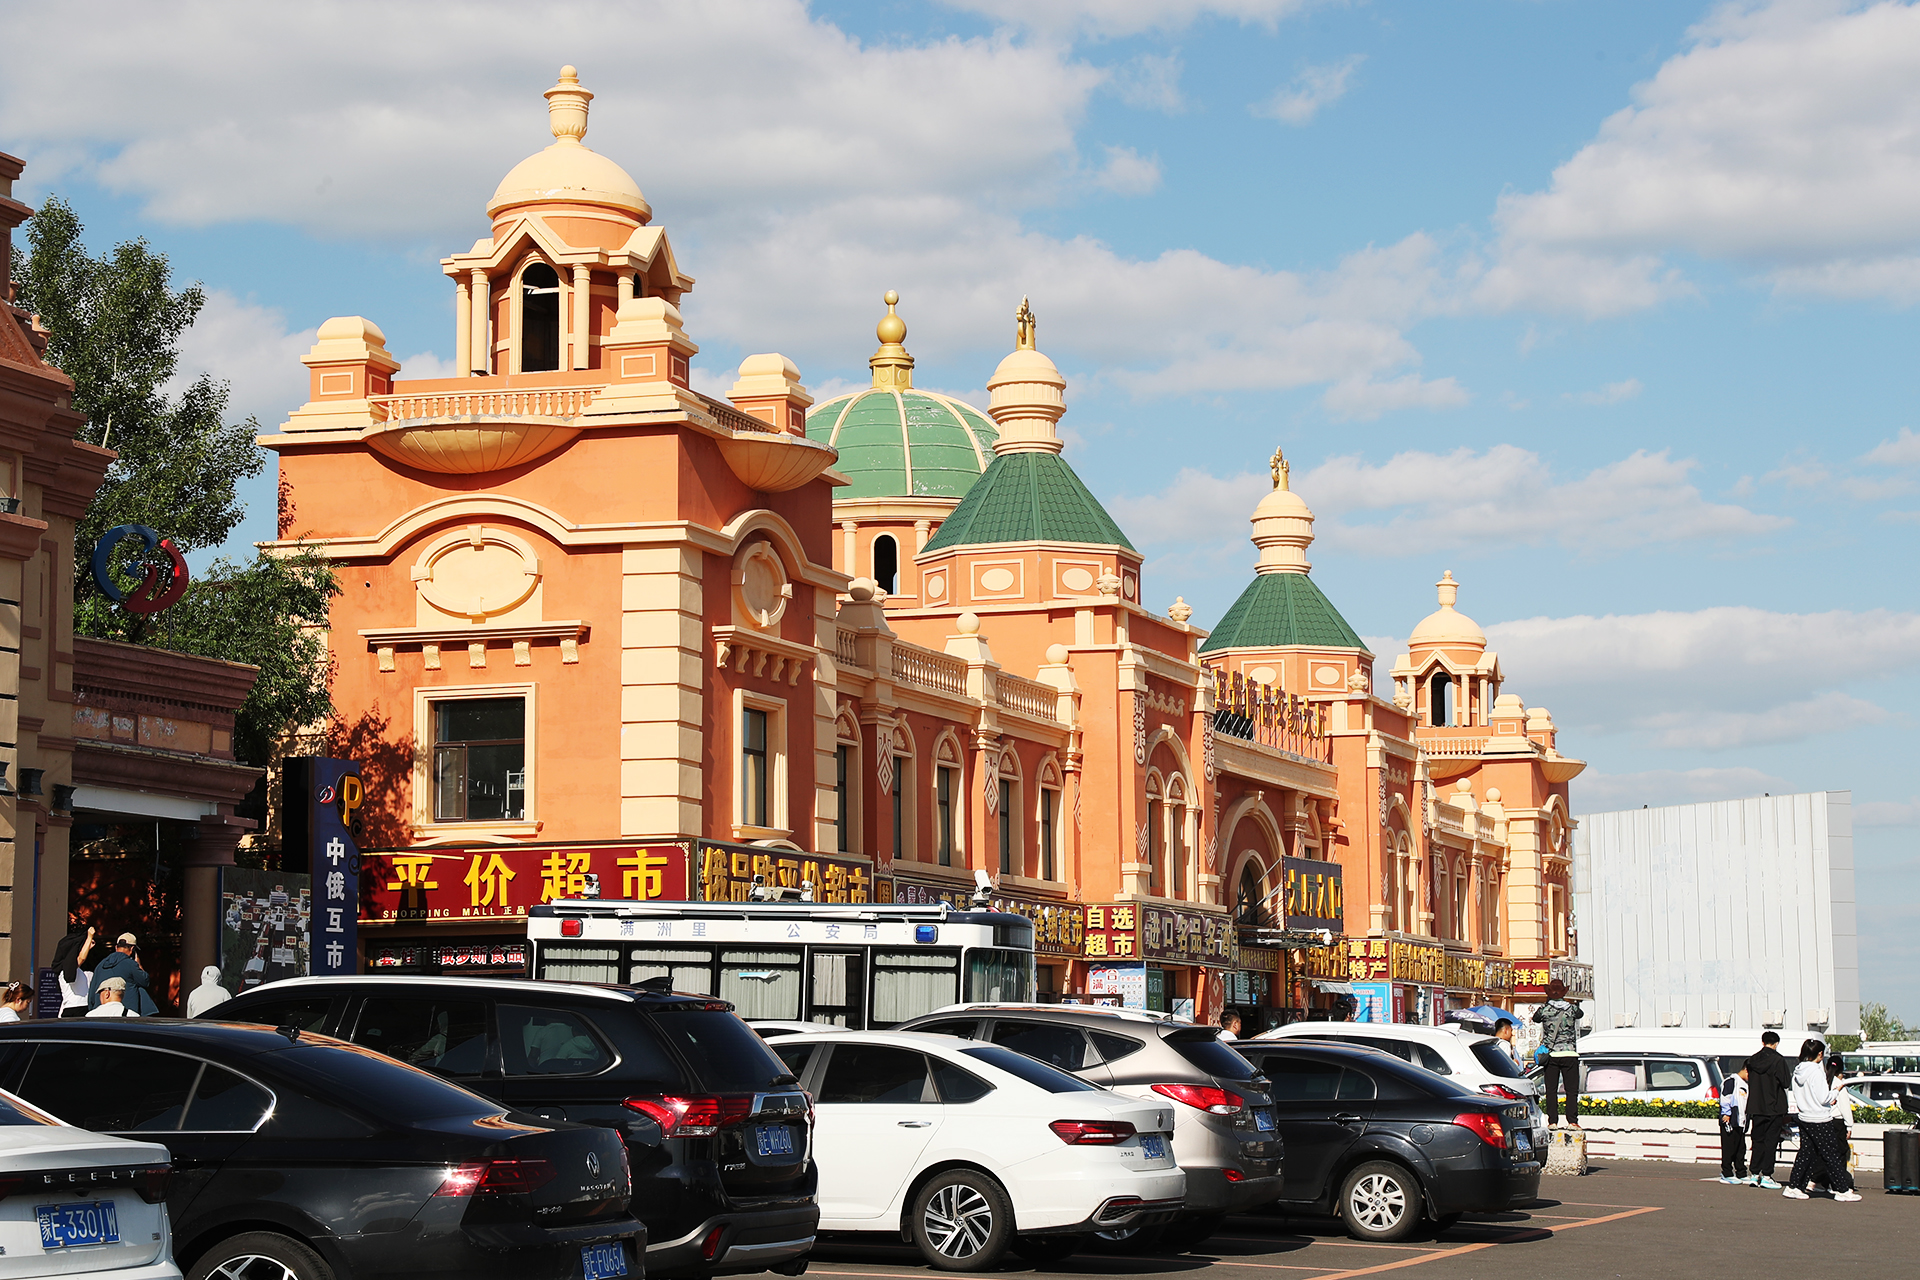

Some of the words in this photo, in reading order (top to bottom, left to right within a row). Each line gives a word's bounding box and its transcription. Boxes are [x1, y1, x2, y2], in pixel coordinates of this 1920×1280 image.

[387, 849, 668, 908] 平价超市
[325, 837, 345, 969] 中俄互市
[383, 908, 450, 919] SHOPPING
[462, 906, 496, 917] MALL
[503, 905, 534, 915] 正品
[1086, 907, 1135, 930] 自选
[620, 921, 707, 937] 满洲里
[786, 923, 878, 940] 公安局
[1085, 933, 1135, 956] 超市
[1348, 940, 1387, 958] 草原
[379, 948, 416, 966] 套娃
[440, 944, 526, 966] 俄罗斯食品
[1348, 960, 1388, 979] 特产
[1514, 968, 1549, 986] 洋酒
